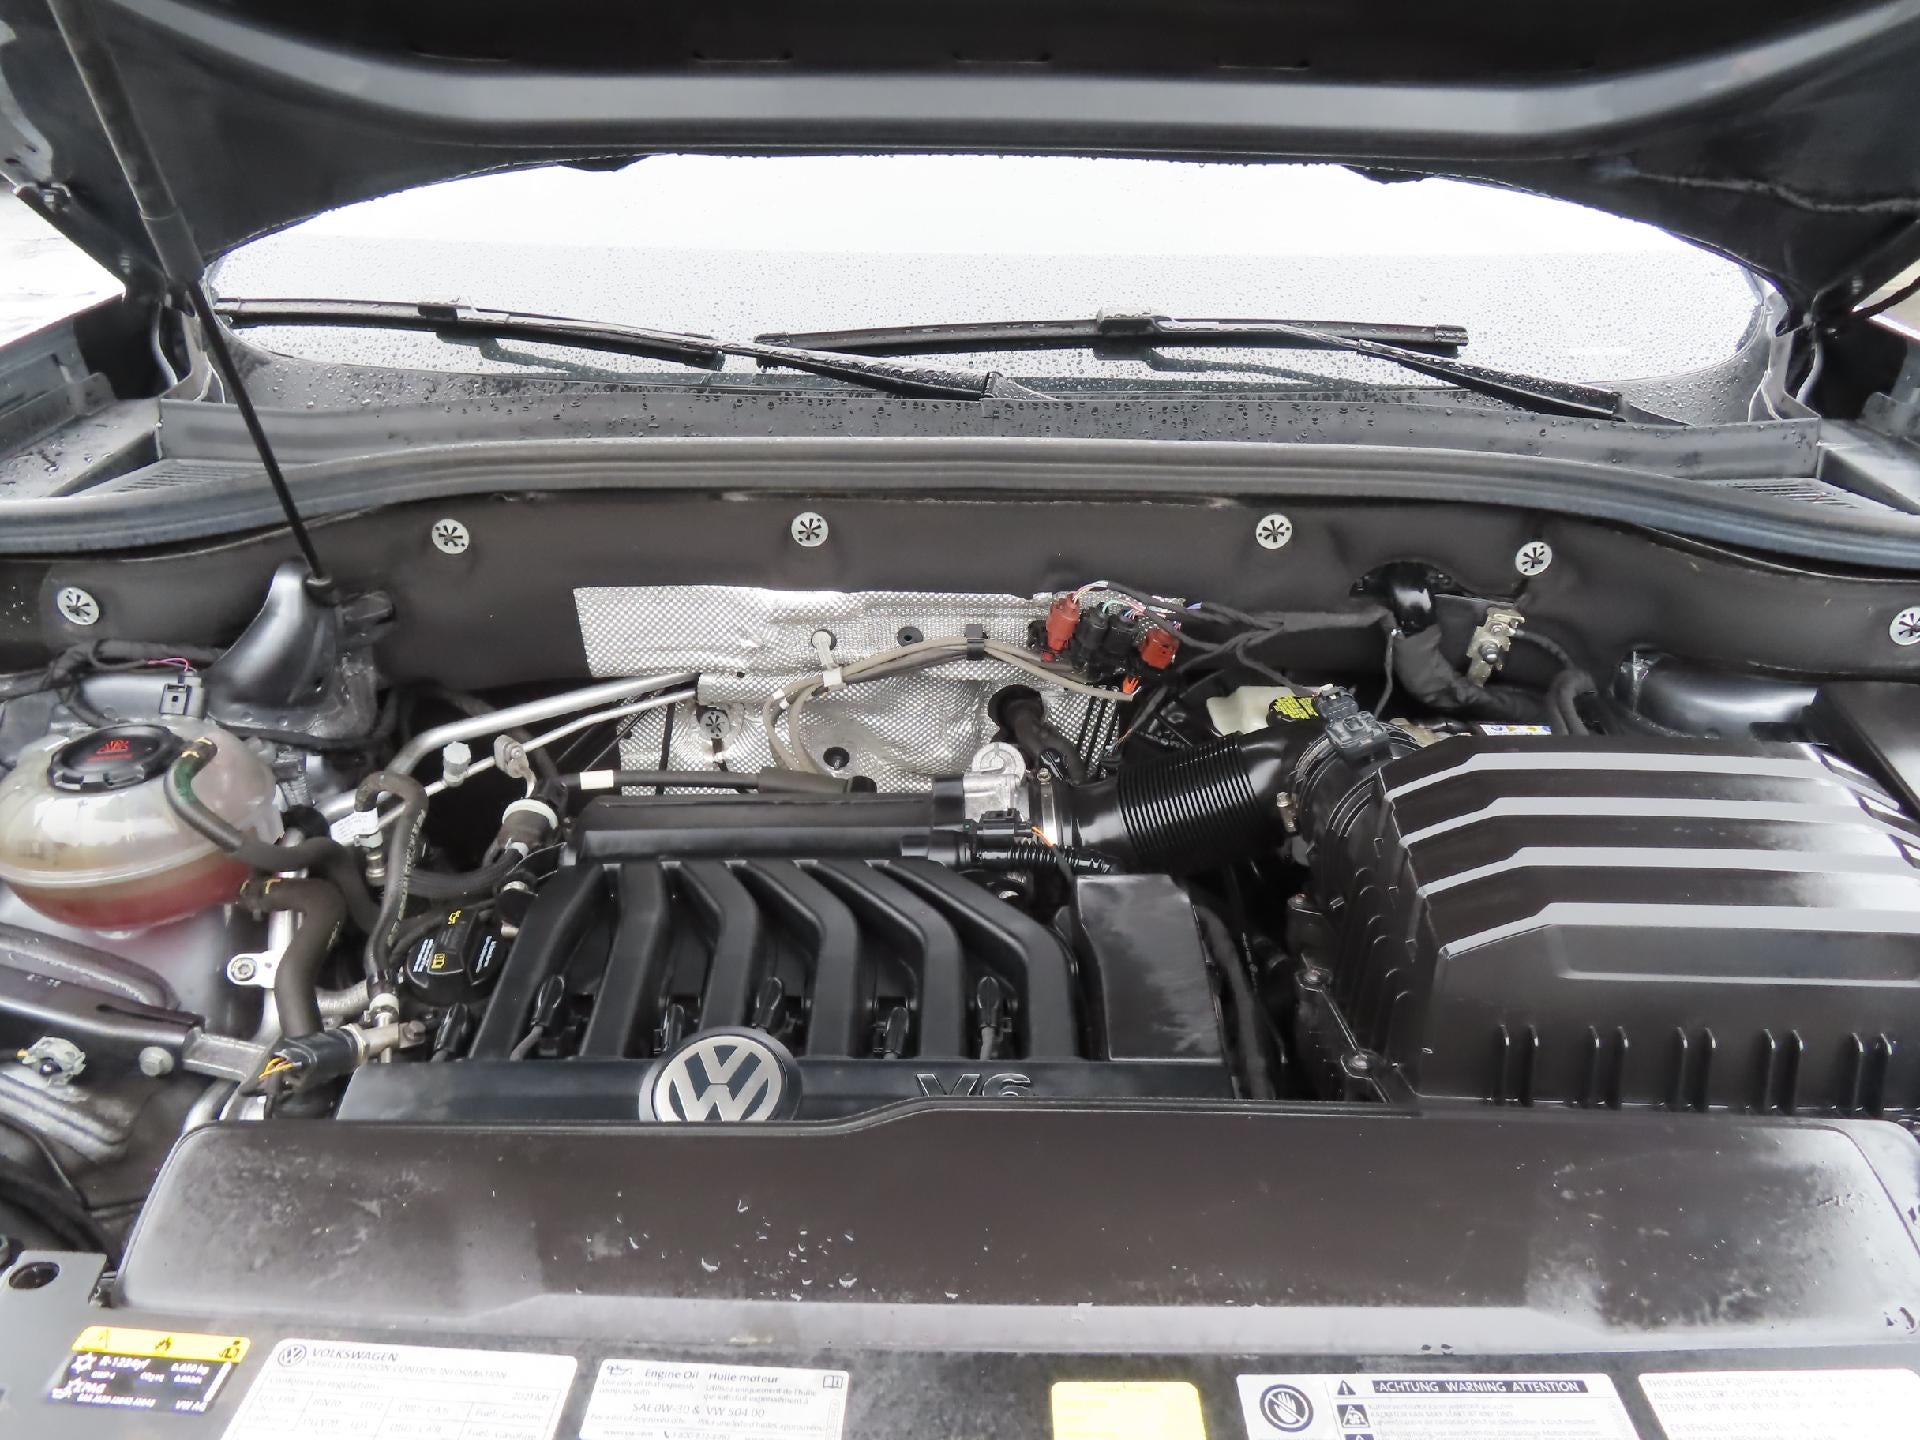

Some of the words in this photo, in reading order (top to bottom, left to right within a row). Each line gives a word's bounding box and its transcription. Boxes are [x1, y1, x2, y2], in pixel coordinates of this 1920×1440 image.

[312, 1347, 399, 1362] VOLKSWAGEN
[644, 1368, 682, 1381] Engine
[683, 1370, 700, 1380] Oil
[708, 1371, 737, 1382] Huile
[738, 1375, 779, 1384] moteur
[1379, 1381, 1439, 1392] ACHTUNG
[1444, 1381, 1507, 1392] WARNING
[1512, 1381, 1580, 1392] ATTENTION
[692, 1405, 700, 1415] &
[706, 1406, 725, 1416] VW
[728, 1407, 748, 1417] 504
